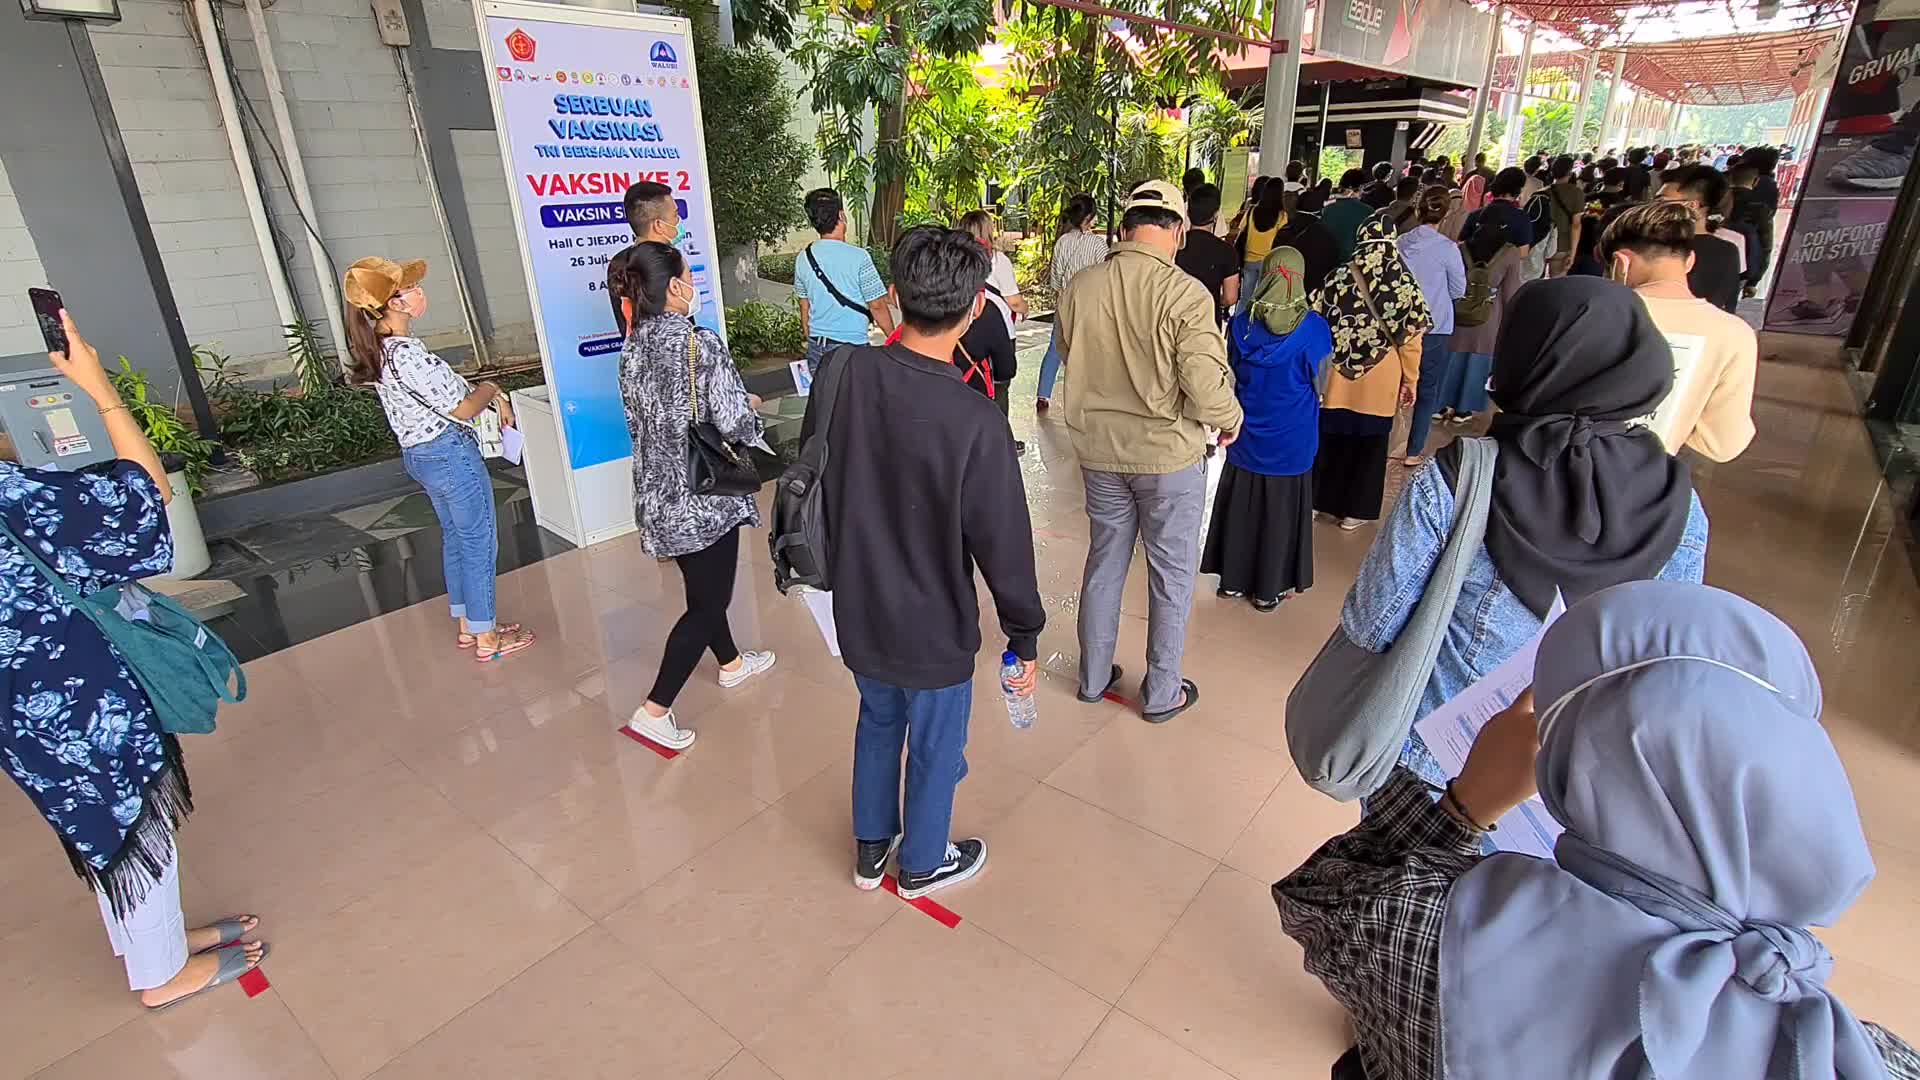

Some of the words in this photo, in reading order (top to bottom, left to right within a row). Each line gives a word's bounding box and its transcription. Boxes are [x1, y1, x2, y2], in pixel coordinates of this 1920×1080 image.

[553, 94, 653, 118] SERBUAN
[548, 118, 664, 142] VAKSINASI
[534, 144, 561, 158] TNI
[562, 145, 629, 159] BERSAMA
[629, 147, 681, 159] WALUBI
[527, 172, 631, 196] VAKSIN
[676, 170, 691, 191] 2
[553, 208, 611, 223] VAKSIN
[548, 238, 573, 250] Hall
[575, 237, 585, 247] C
[587, 234, 629, 247] JIEXPO
[1790, 246, 1825, 264] AND
[1827, 238, 1882, 259] STYLE
[570, 257, 585, 267] 26
[587, 253, 609, 266] Juli
[588, 281, 597, 291] 8
